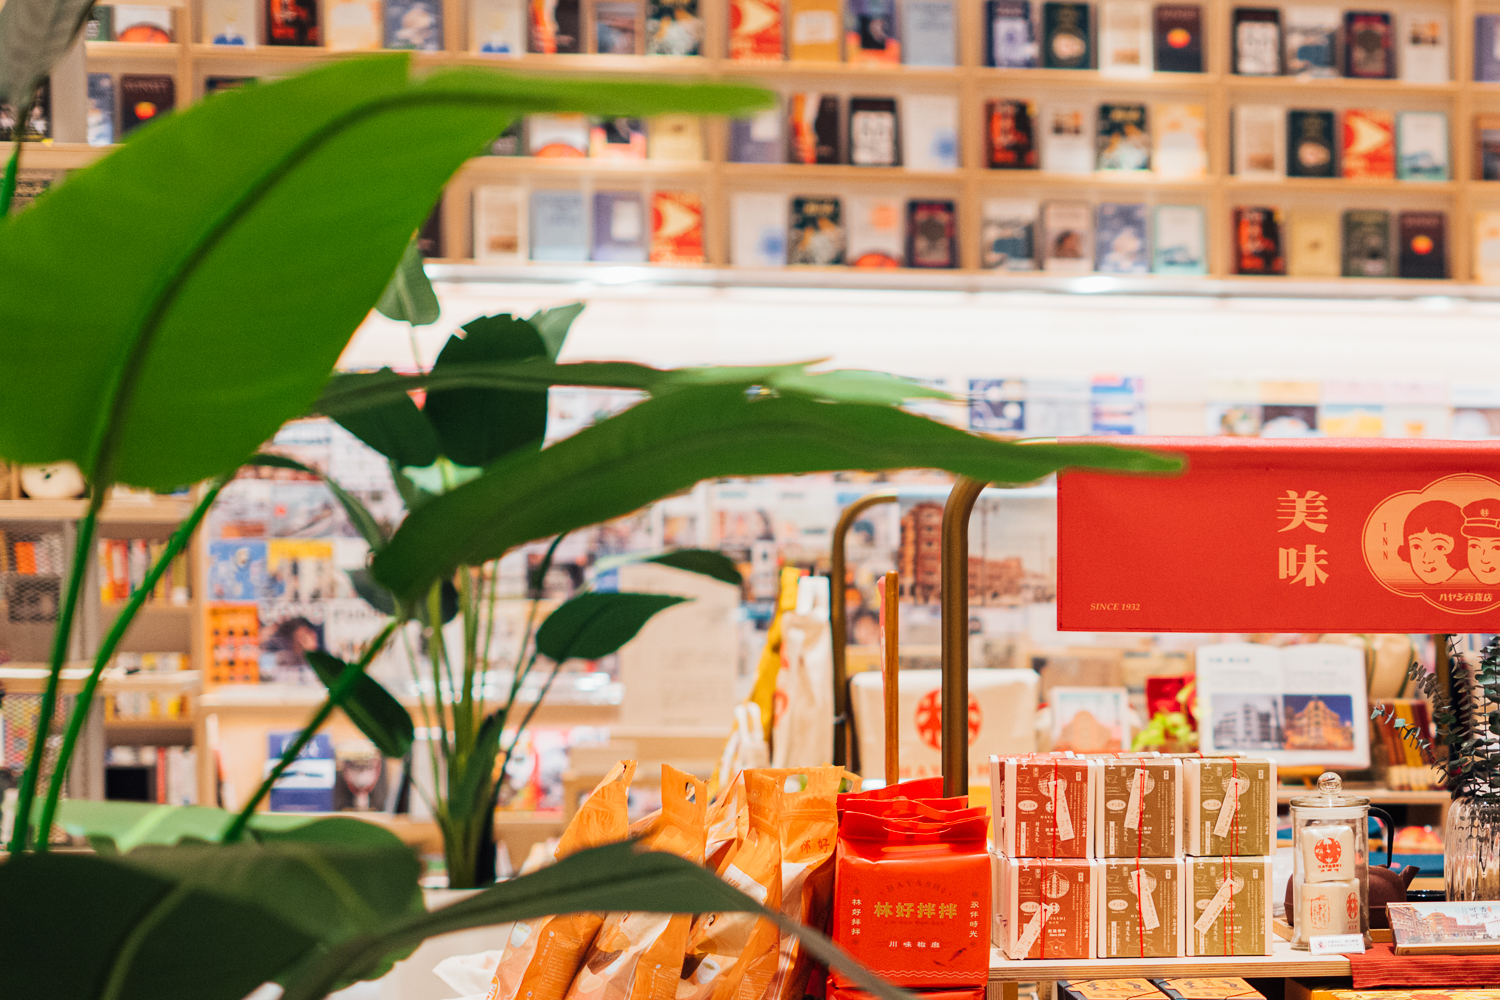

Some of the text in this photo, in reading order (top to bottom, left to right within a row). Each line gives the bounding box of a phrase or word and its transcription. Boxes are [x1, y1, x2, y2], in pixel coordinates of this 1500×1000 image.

[1276, 489, 1330, 587] 美味
[1438, 592, 1493, 603] ハヤシ百貨店
[1090, 603, 1141, 611] SINCE 1932
[874, 901, 958, 919] 林好拌拌
